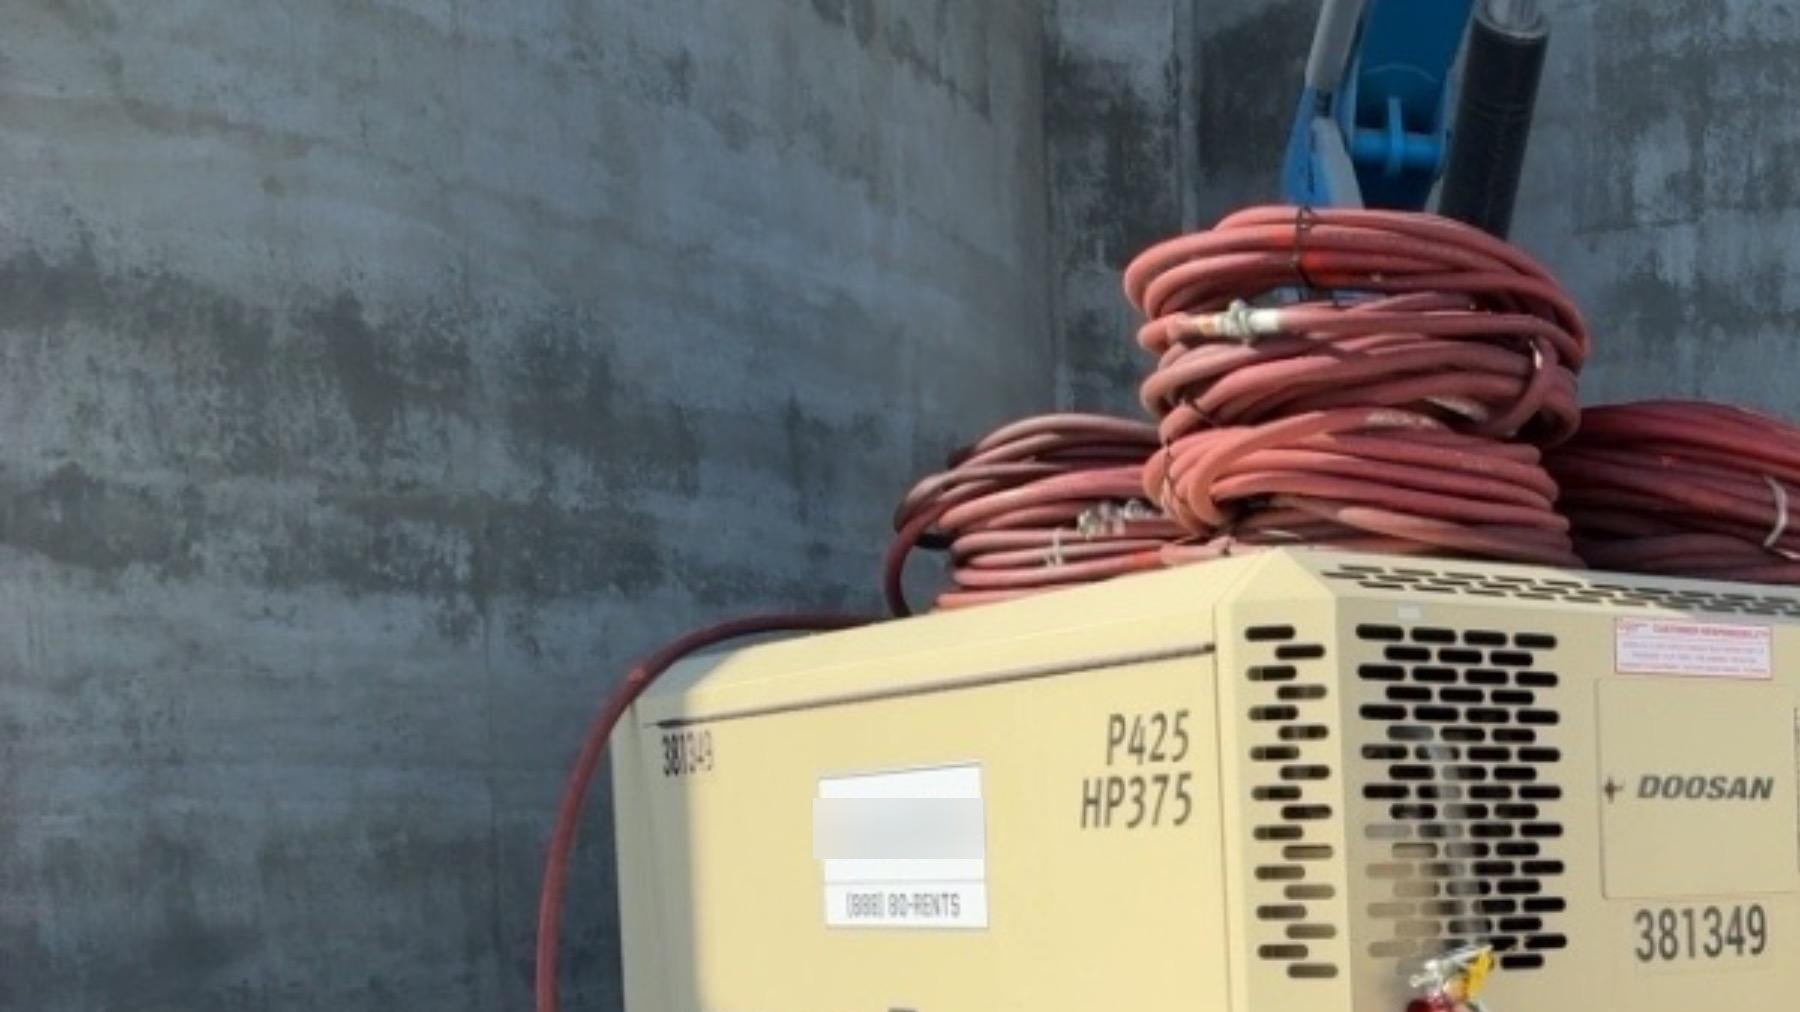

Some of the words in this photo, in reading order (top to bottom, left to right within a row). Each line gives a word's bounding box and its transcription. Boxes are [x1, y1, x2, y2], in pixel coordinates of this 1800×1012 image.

[1106, 708, 1191, 767] P425
[1080, 771, 1193, 830] HP375
[1636, 774, 1775, 801] DOOSAN
[1634, 904, 1767, 964] 381349
